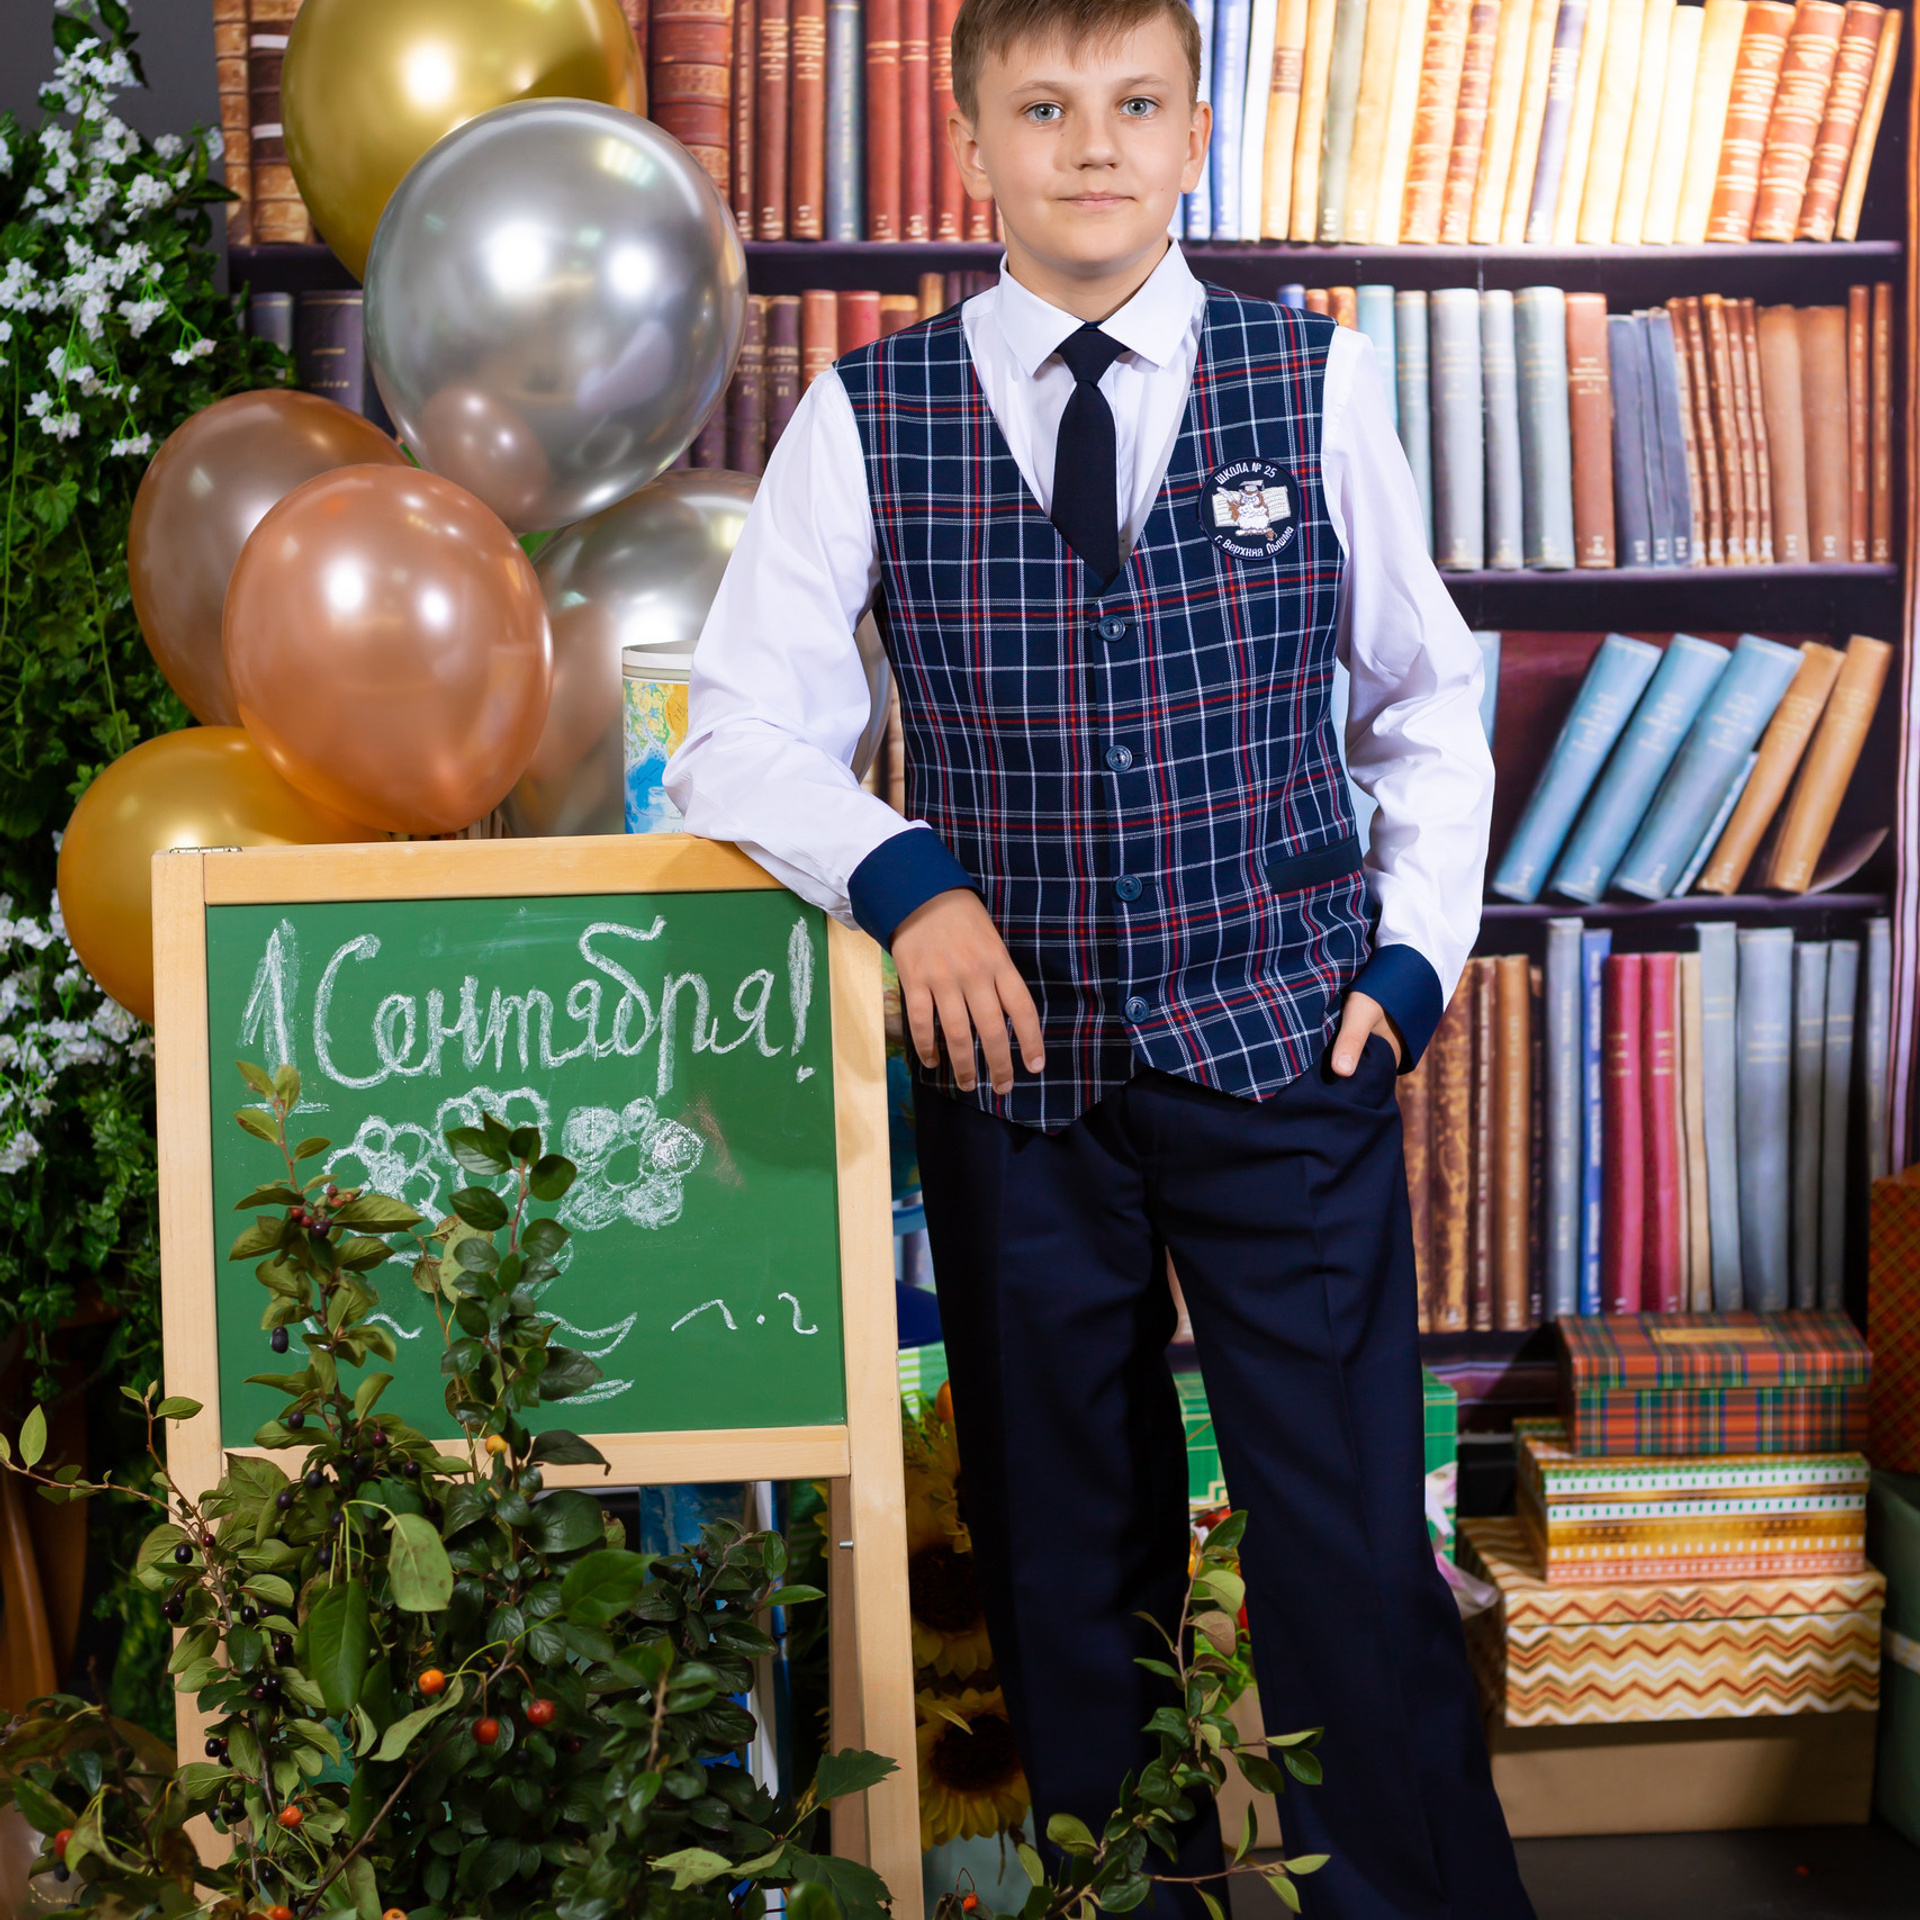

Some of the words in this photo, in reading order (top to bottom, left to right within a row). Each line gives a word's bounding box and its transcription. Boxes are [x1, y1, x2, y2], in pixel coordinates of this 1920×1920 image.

[1215, 462, 1249, 484] ШКОЛА
[1251, 462, 1262, 473] №
[1263, 465, 1278, 478] 25
[1223, 539, 1263, 556] Верхняя
[1266, 526, 1294, 554] Пышма
[238, 918, 329, 1112] 1
[312, 915, 817, 1100] Сентября!
